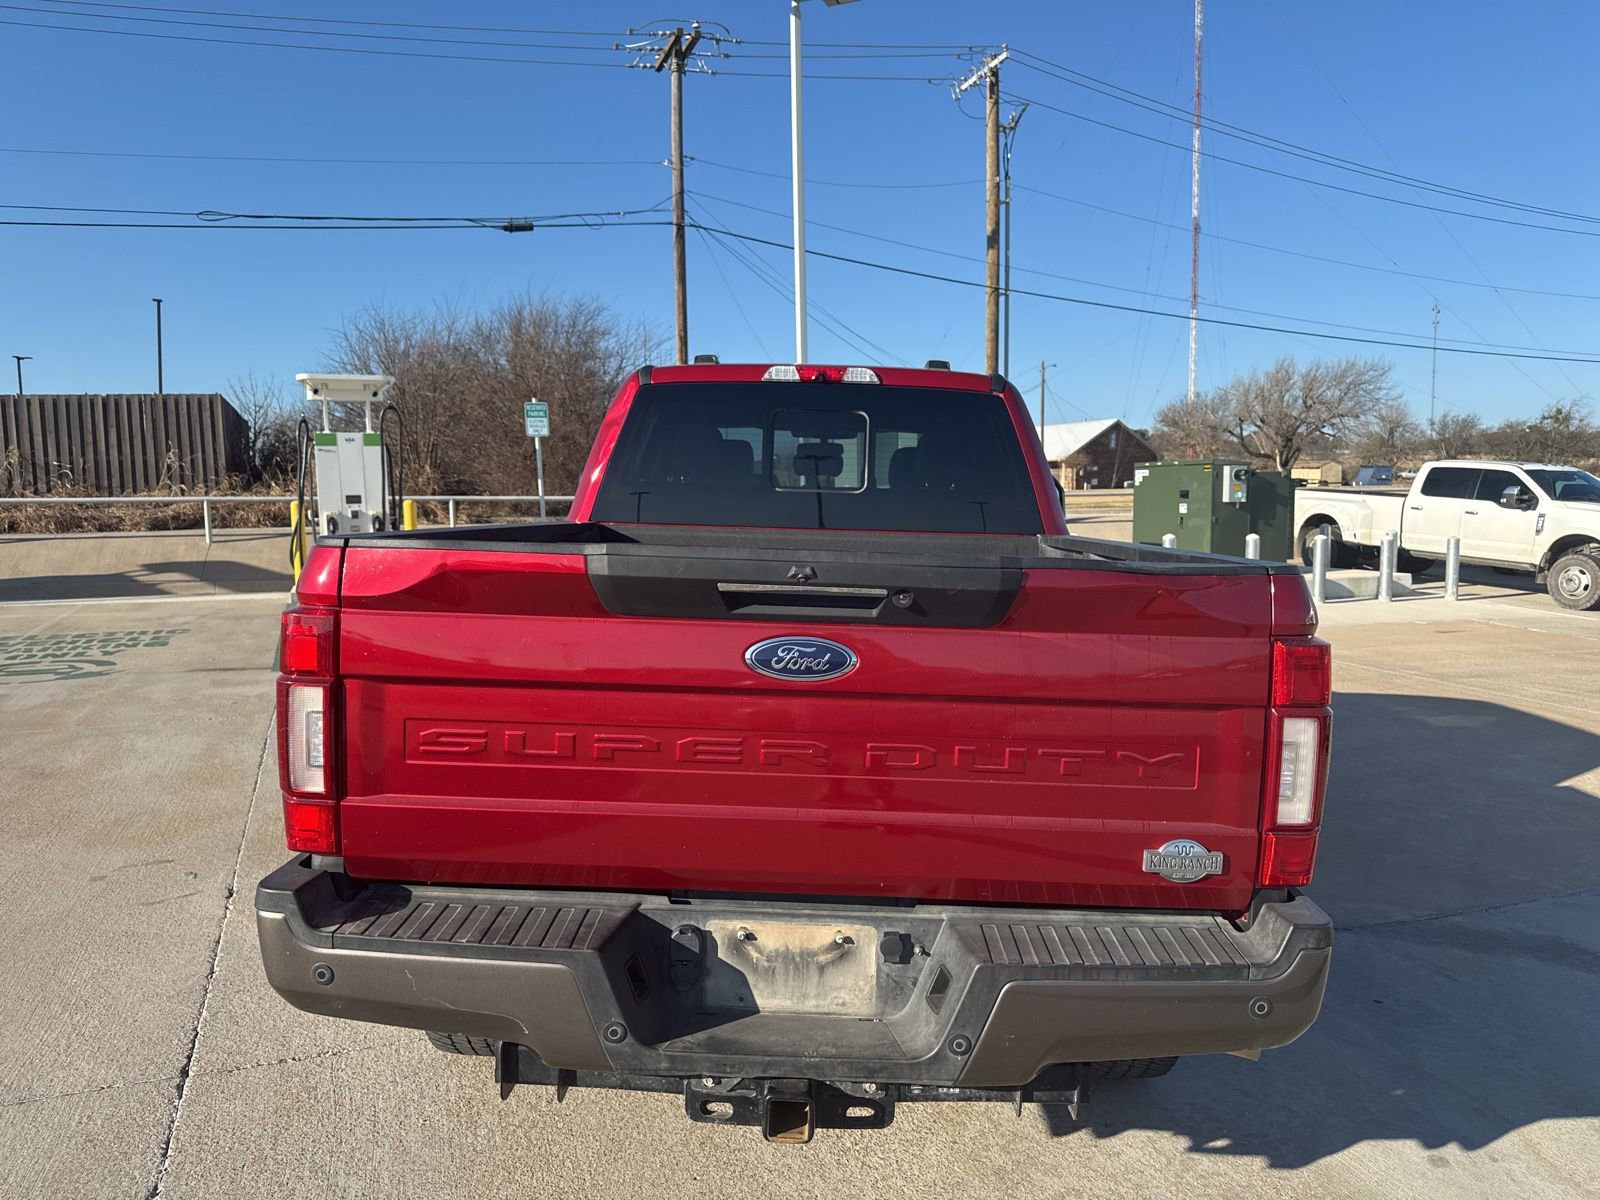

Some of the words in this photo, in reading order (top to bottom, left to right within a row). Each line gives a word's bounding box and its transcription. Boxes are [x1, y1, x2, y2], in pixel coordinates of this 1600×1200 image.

[0, 628, 191, 641] ELECTRIC
[4, 649, 126, 660] ONLY
[771, 645, 831, 670] Ford
[418, 727, 831, 768] SUPER
[865, 743, 1185, 779] DUTY
[1149, 855, 1179, 870] KING
[1181, 856, 1220, 871] RANCH
